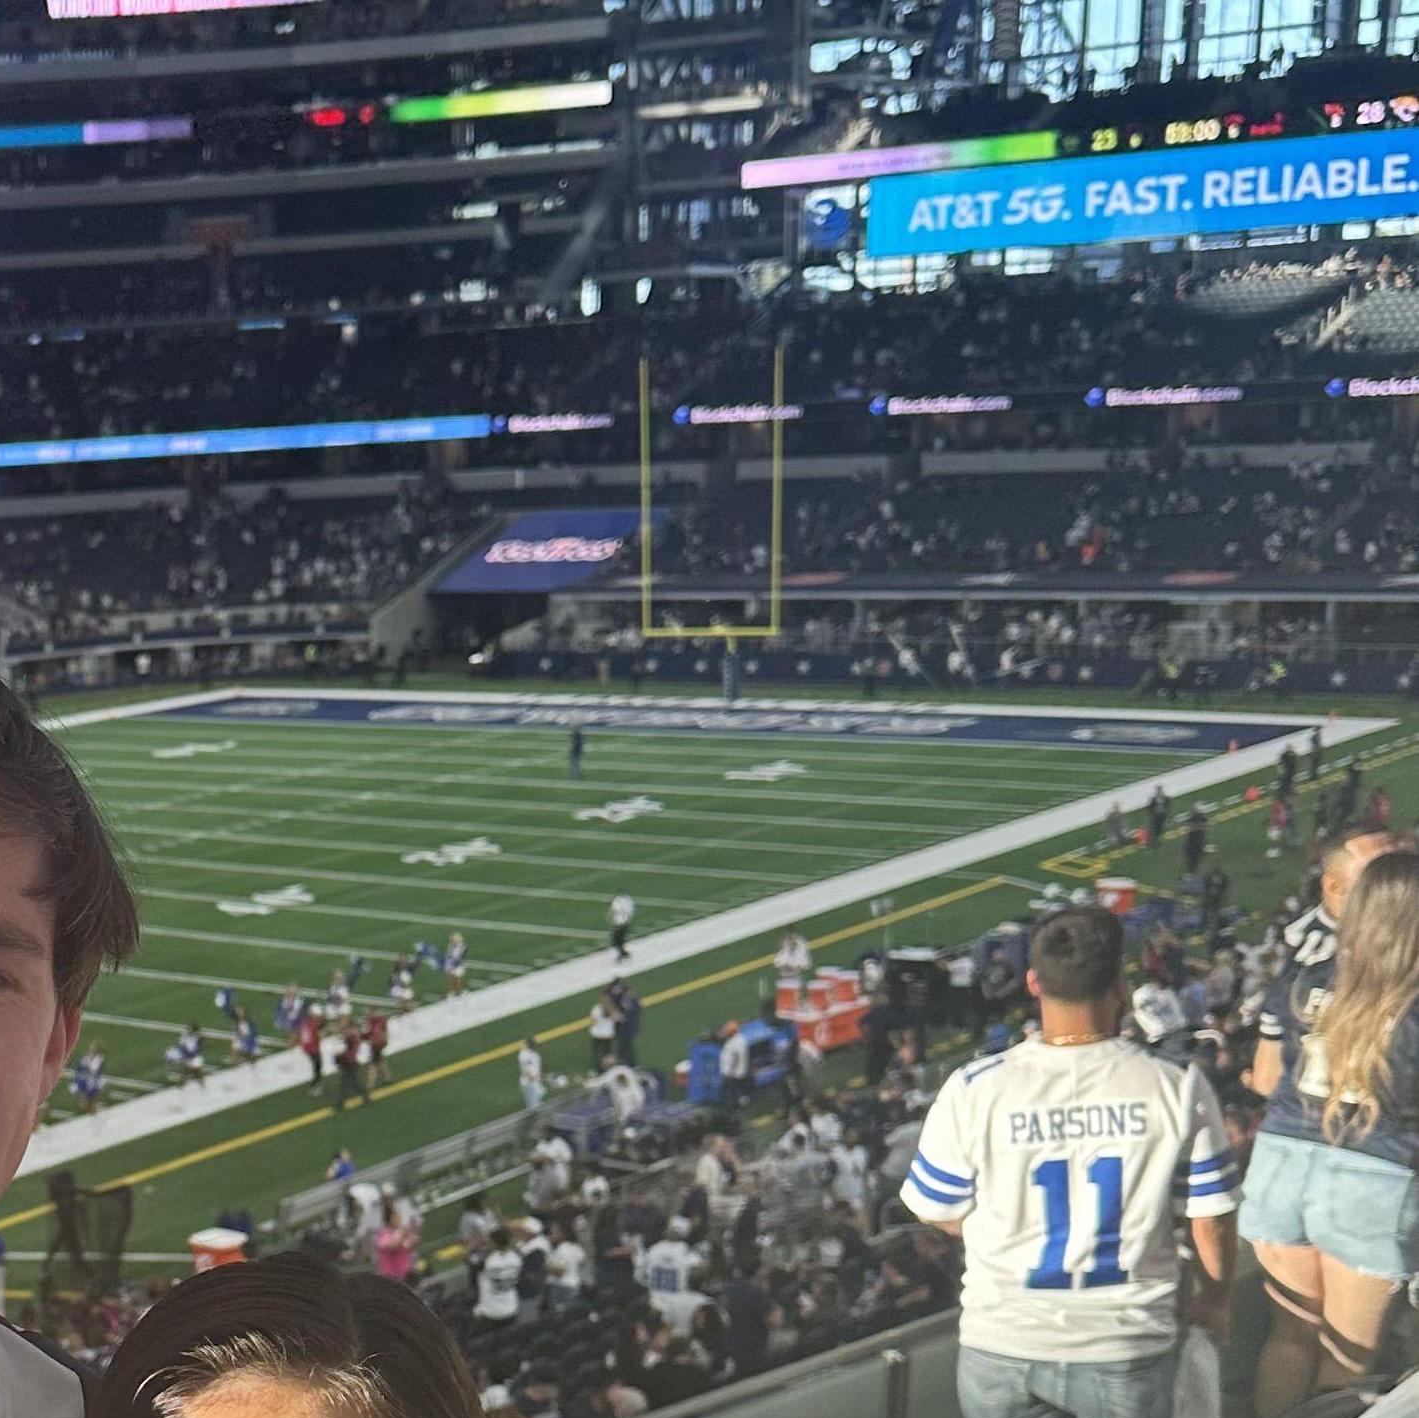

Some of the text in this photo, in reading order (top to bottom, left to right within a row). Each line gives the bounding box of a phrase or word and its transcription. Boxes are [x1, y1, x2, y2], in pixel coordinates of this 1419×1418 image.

[908, 192, 999, 234] AT&T
[1084, 174, 1194, 219] FAST.
[1203, 153, 1419, 210] RELIABLE.
[1009, 1102, 1148, 1145] PARSONS
[1025, 1156, 1131, 1291] 11
